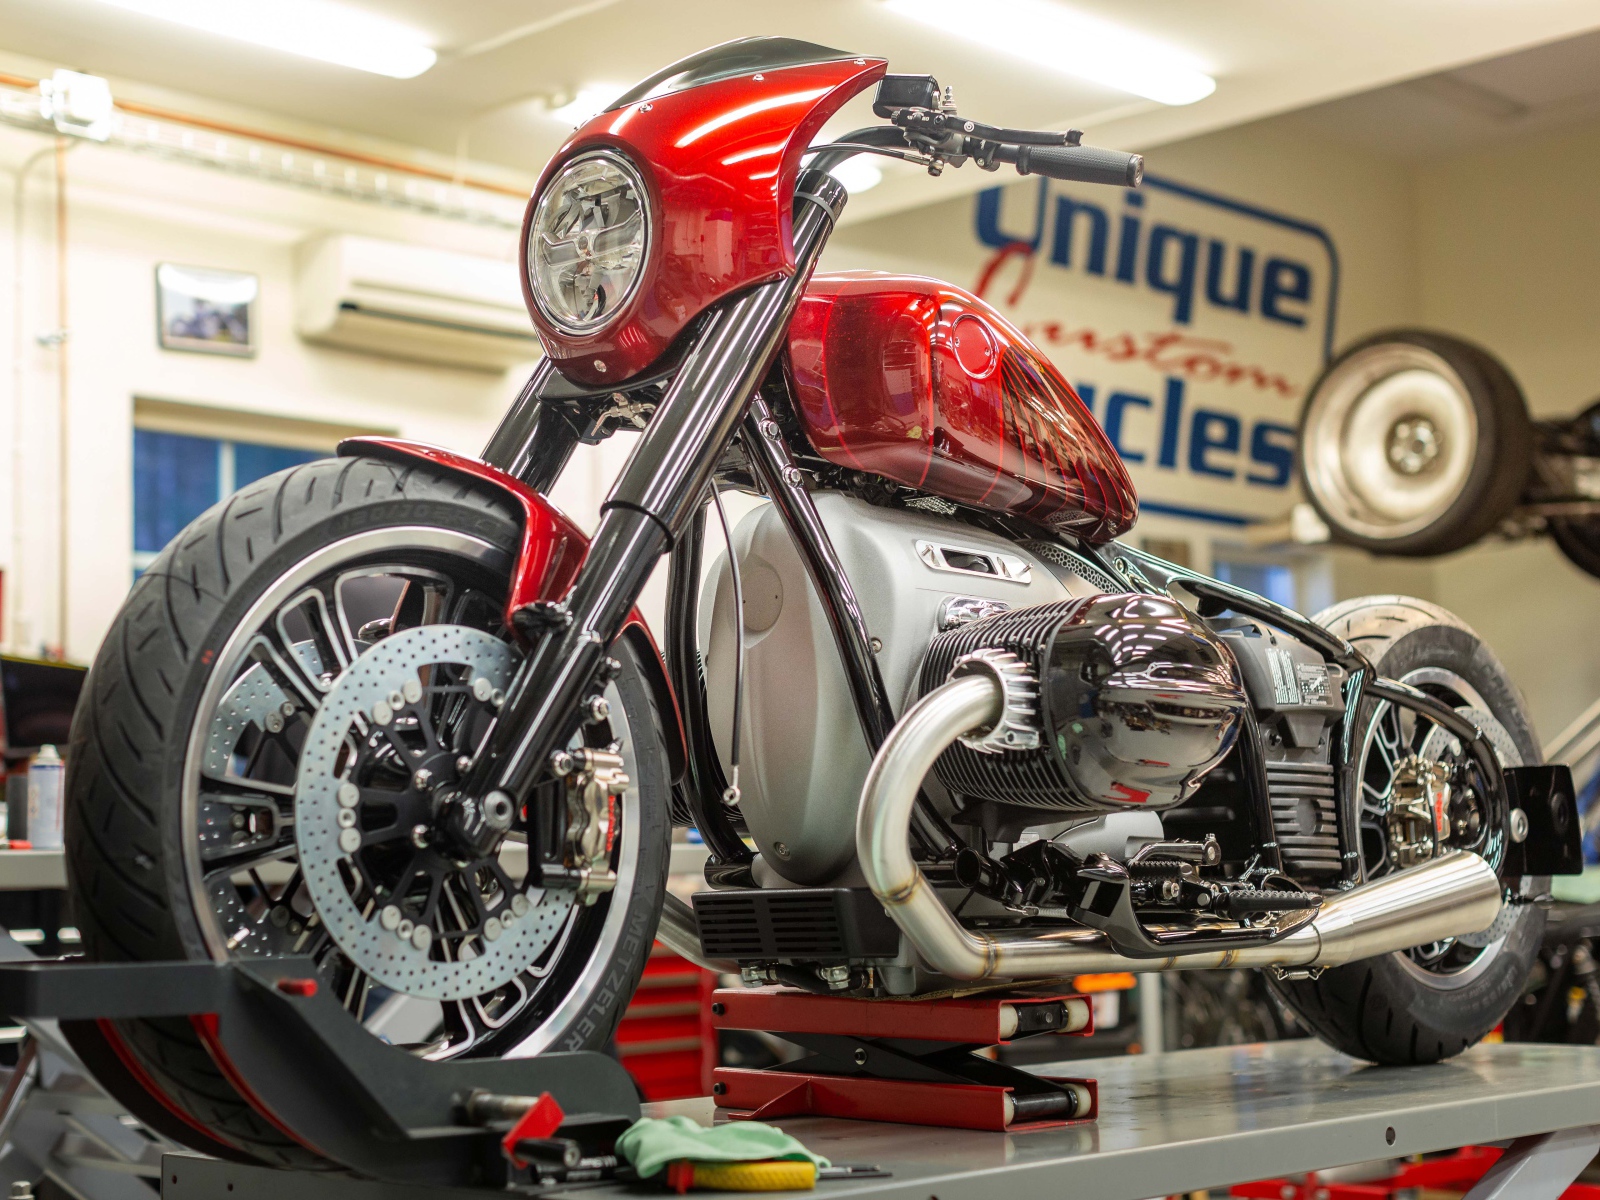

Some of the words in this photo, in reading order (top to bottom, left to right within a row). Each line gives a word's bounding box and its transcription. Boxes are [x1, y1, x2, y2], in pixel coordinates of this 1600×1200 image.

[975, 176, 1311, 328] Unique
[1077, 376, 1296, 488] cles
[564, 912, 648, 1052] METZELER
